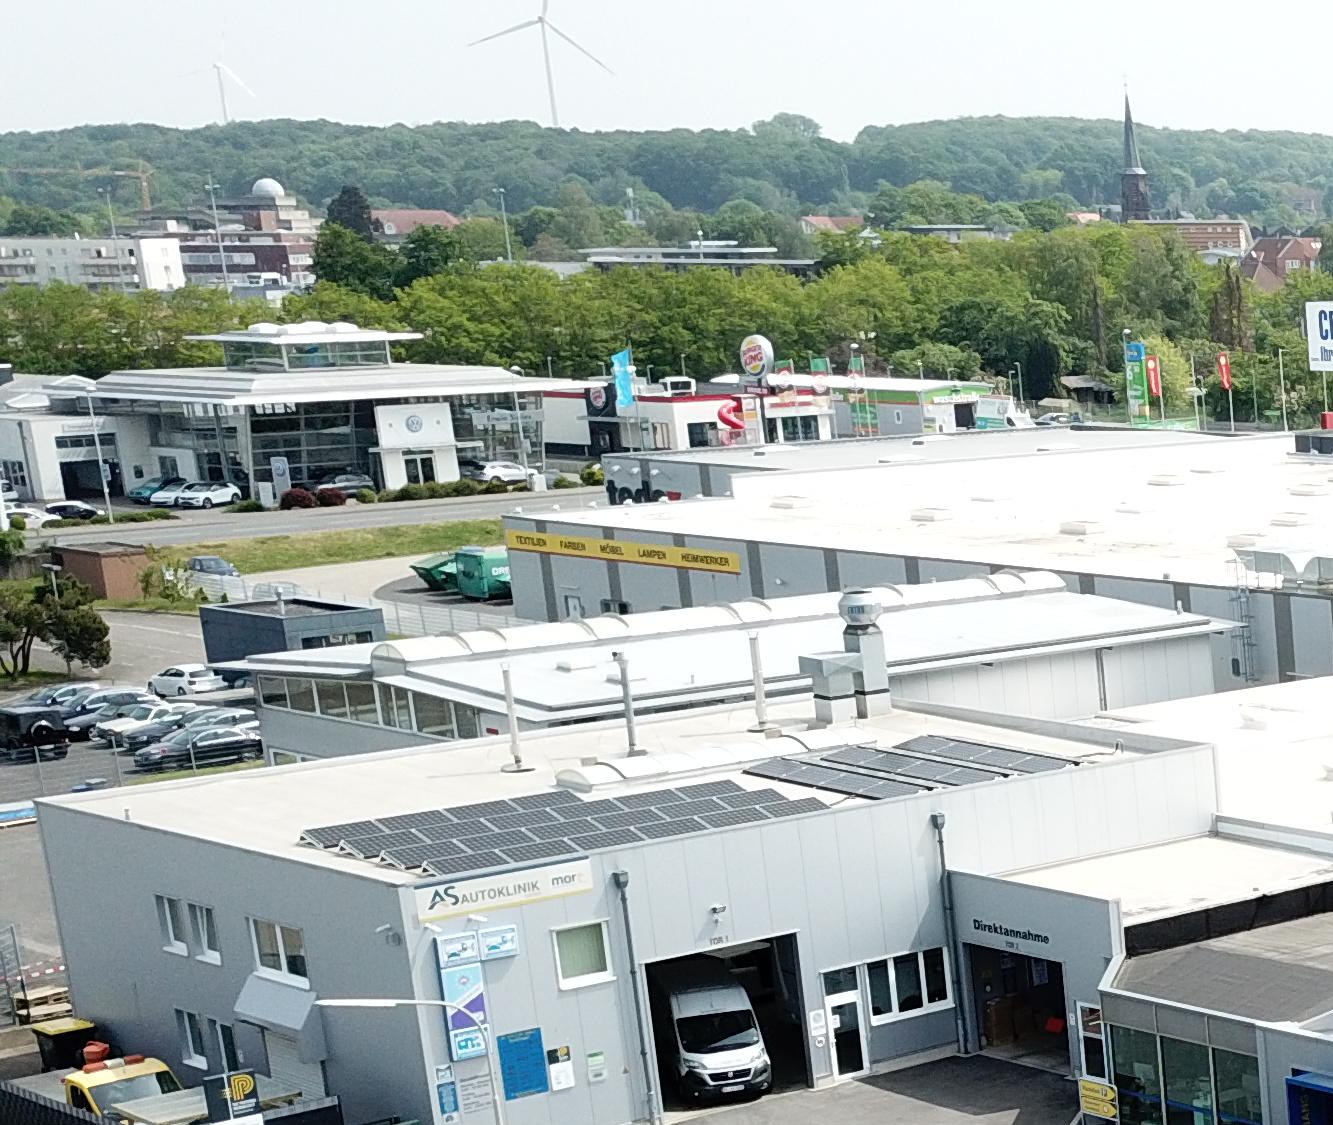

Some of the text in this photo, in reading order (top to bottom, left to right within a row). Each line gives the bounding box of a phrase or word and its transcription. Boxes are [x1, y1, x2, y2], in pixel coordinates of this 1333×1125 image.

[1320, 346, 1333, 361] Ihr
[515, 535, 731, 567] TEXTILIEN FARBEN MÖBEL LAMPEN HEIMWERKER
[427, 880, 541, 911] AS AUTOKLINIK
[973, 918, 1050, 945] Direktannahme
